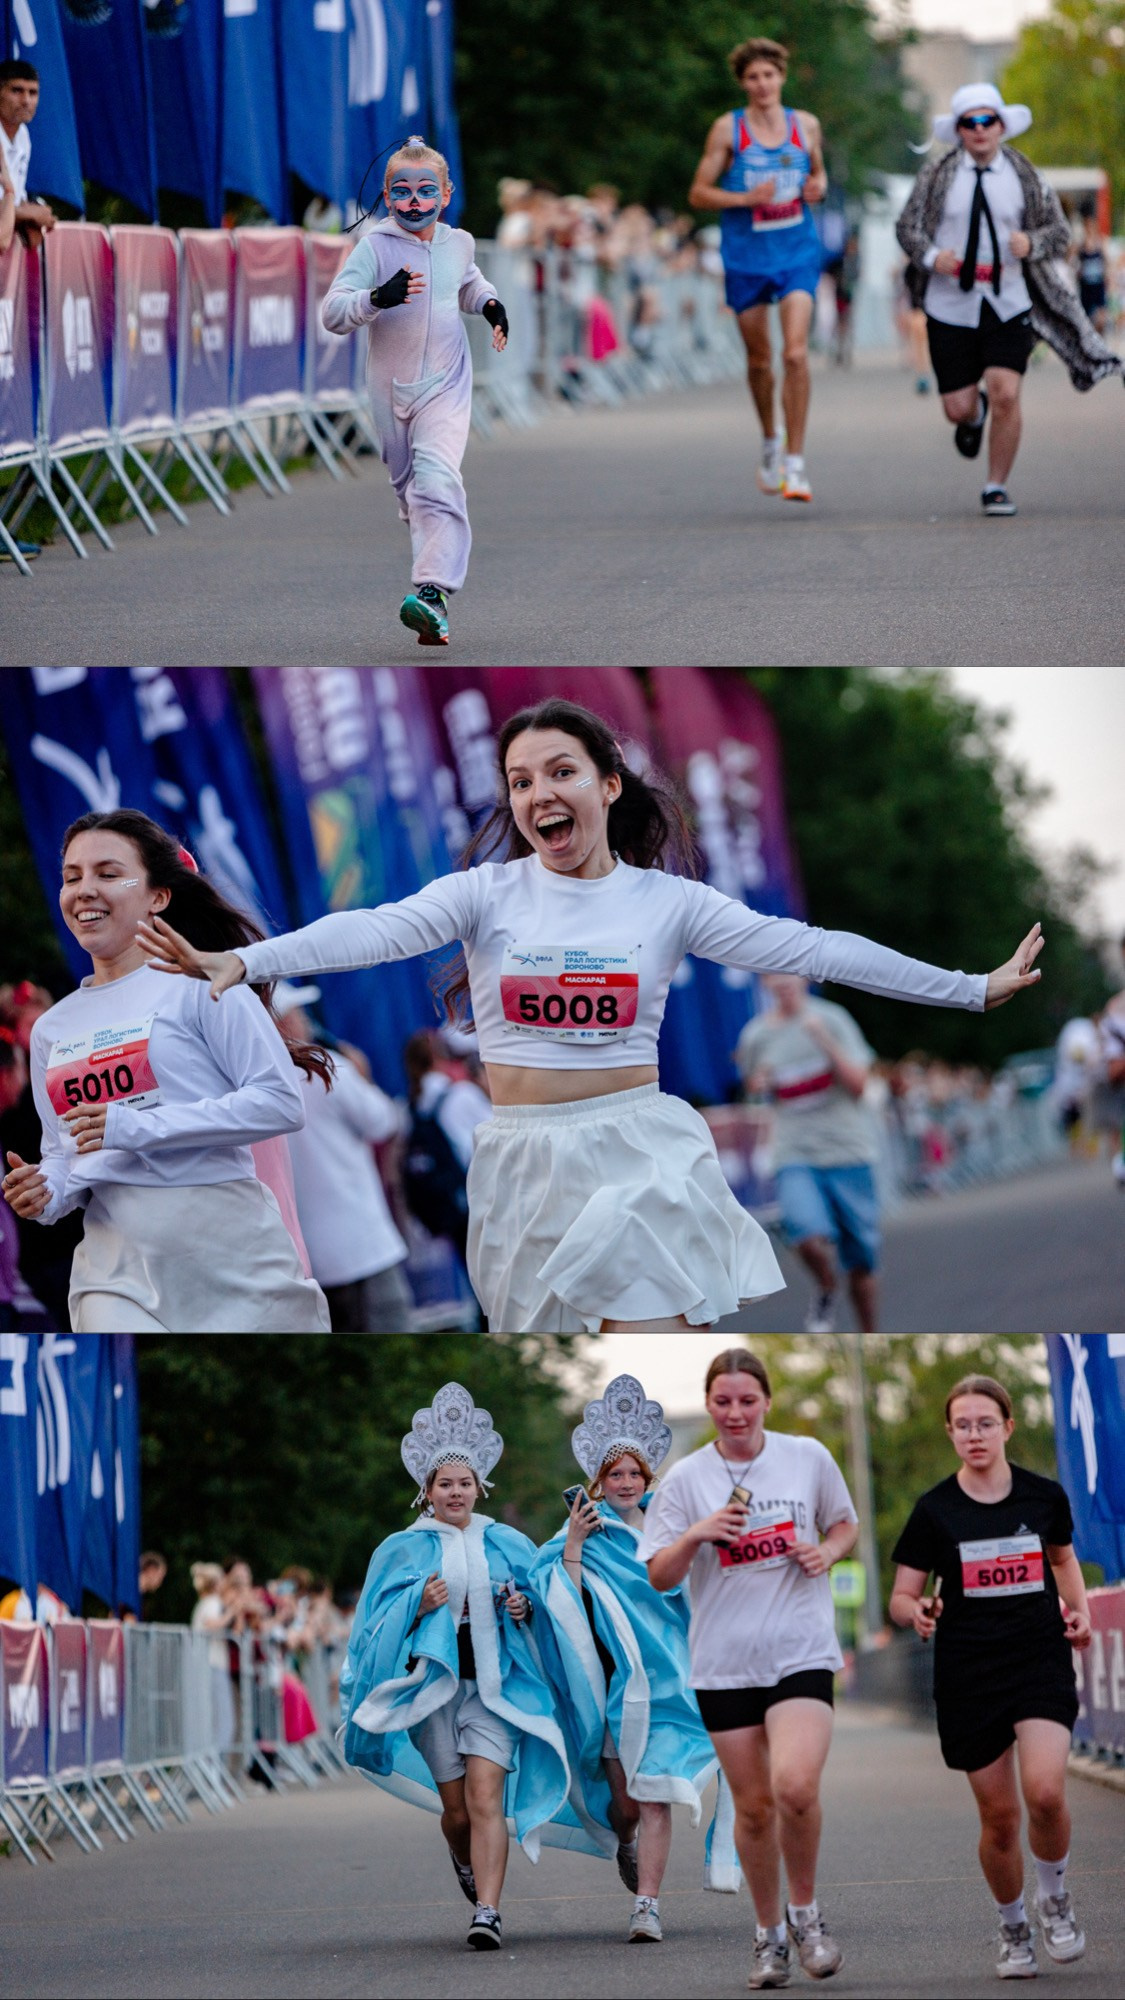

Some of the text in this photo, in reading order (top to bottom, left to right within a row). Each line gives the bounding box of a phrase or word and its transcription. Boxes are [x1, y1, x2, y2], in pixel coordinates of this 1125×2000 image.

[564, 976, 607, 984] МАСКАРАД
[519, 994, 618, 1025] 5008
[93, 1027, 143, 1043] УРАЛ ЛОГИСТИКИ
[94, 1029, 112, 1037] КУБОК
[93, 1037, 124, 1050] ВОРОНОВО
[92, 1048, 124, 1062] МАСКАРАД
[63, 1064, 134, 1107] 5010
[729, 1537, 787, 1564] 5009
[978, 1565, 1029, 1587] 5012
